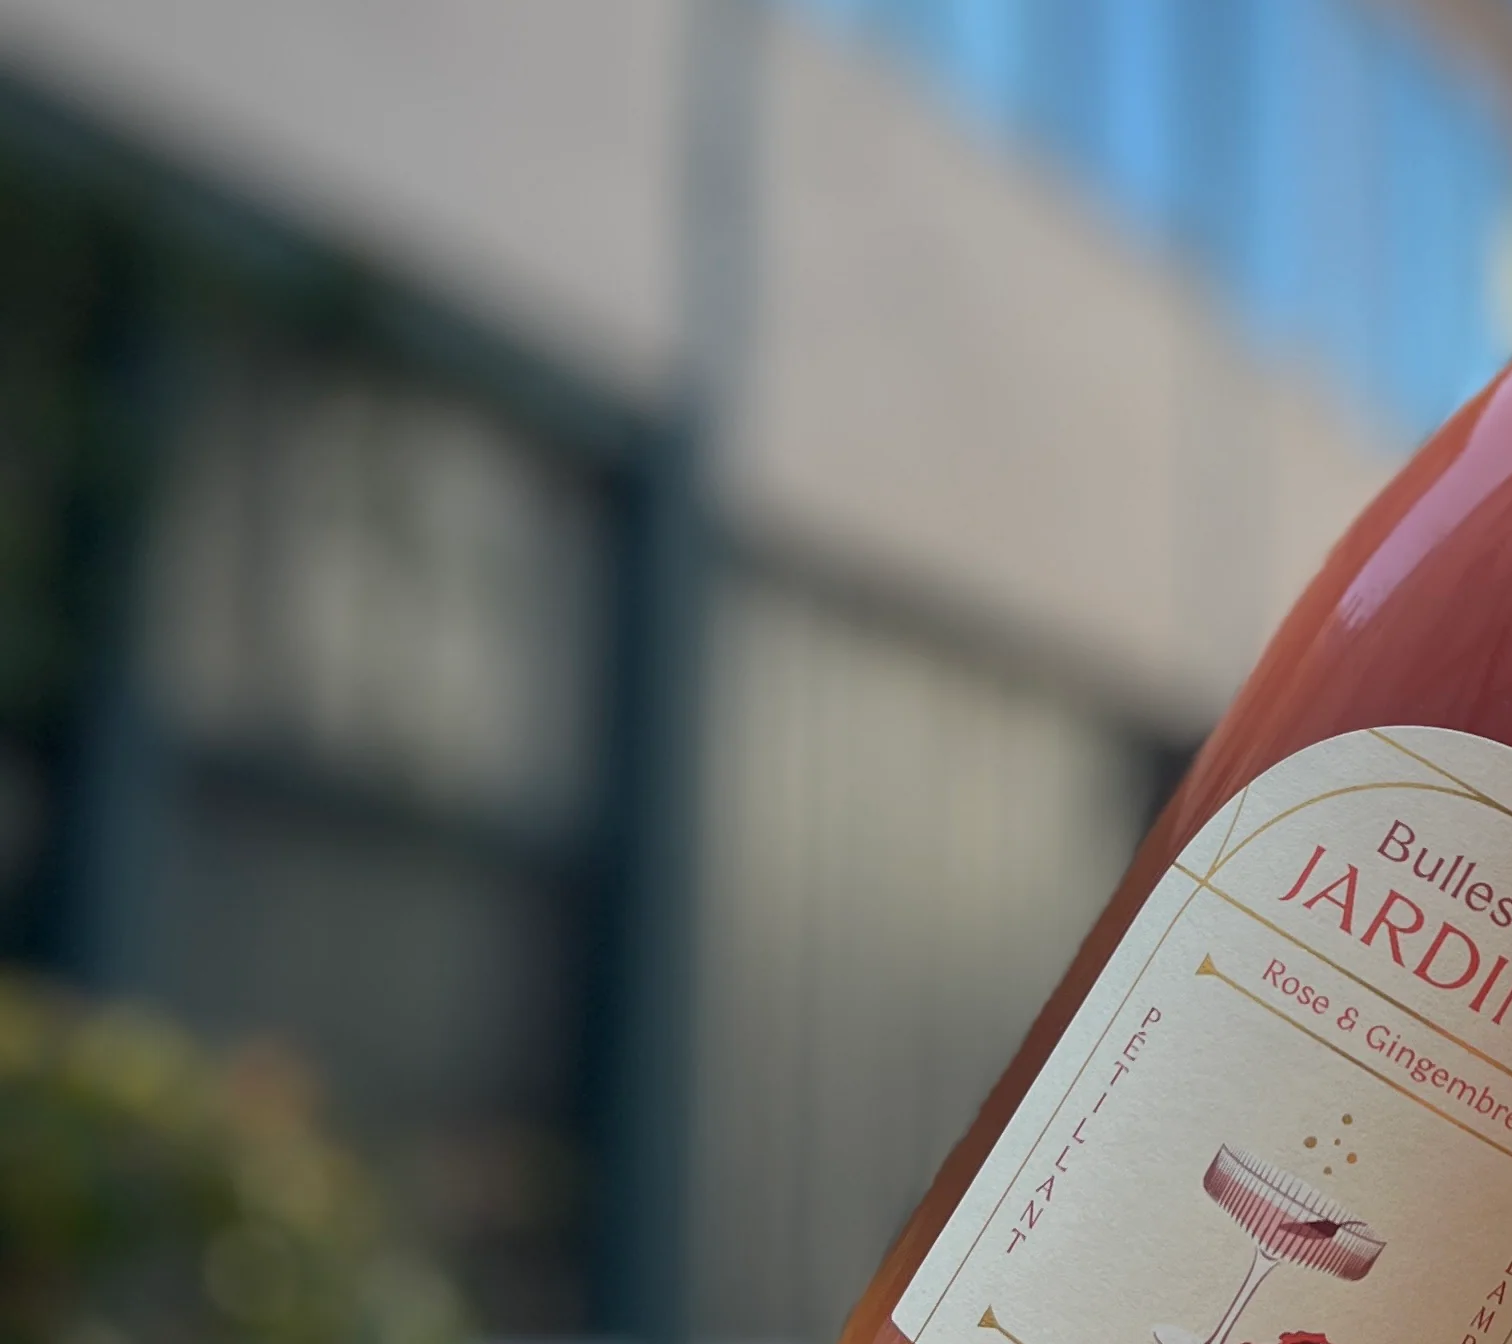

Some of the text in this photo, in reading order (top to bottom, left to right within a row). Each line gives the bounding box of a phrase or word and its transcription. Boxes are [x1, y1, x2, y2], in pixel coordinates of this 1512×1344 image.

[1262, 958, 1330, 1015] Rose
[1336, 1007, 1360, 1032] &
[1006, 1006, 1162, 1254] PÉTILLANT
